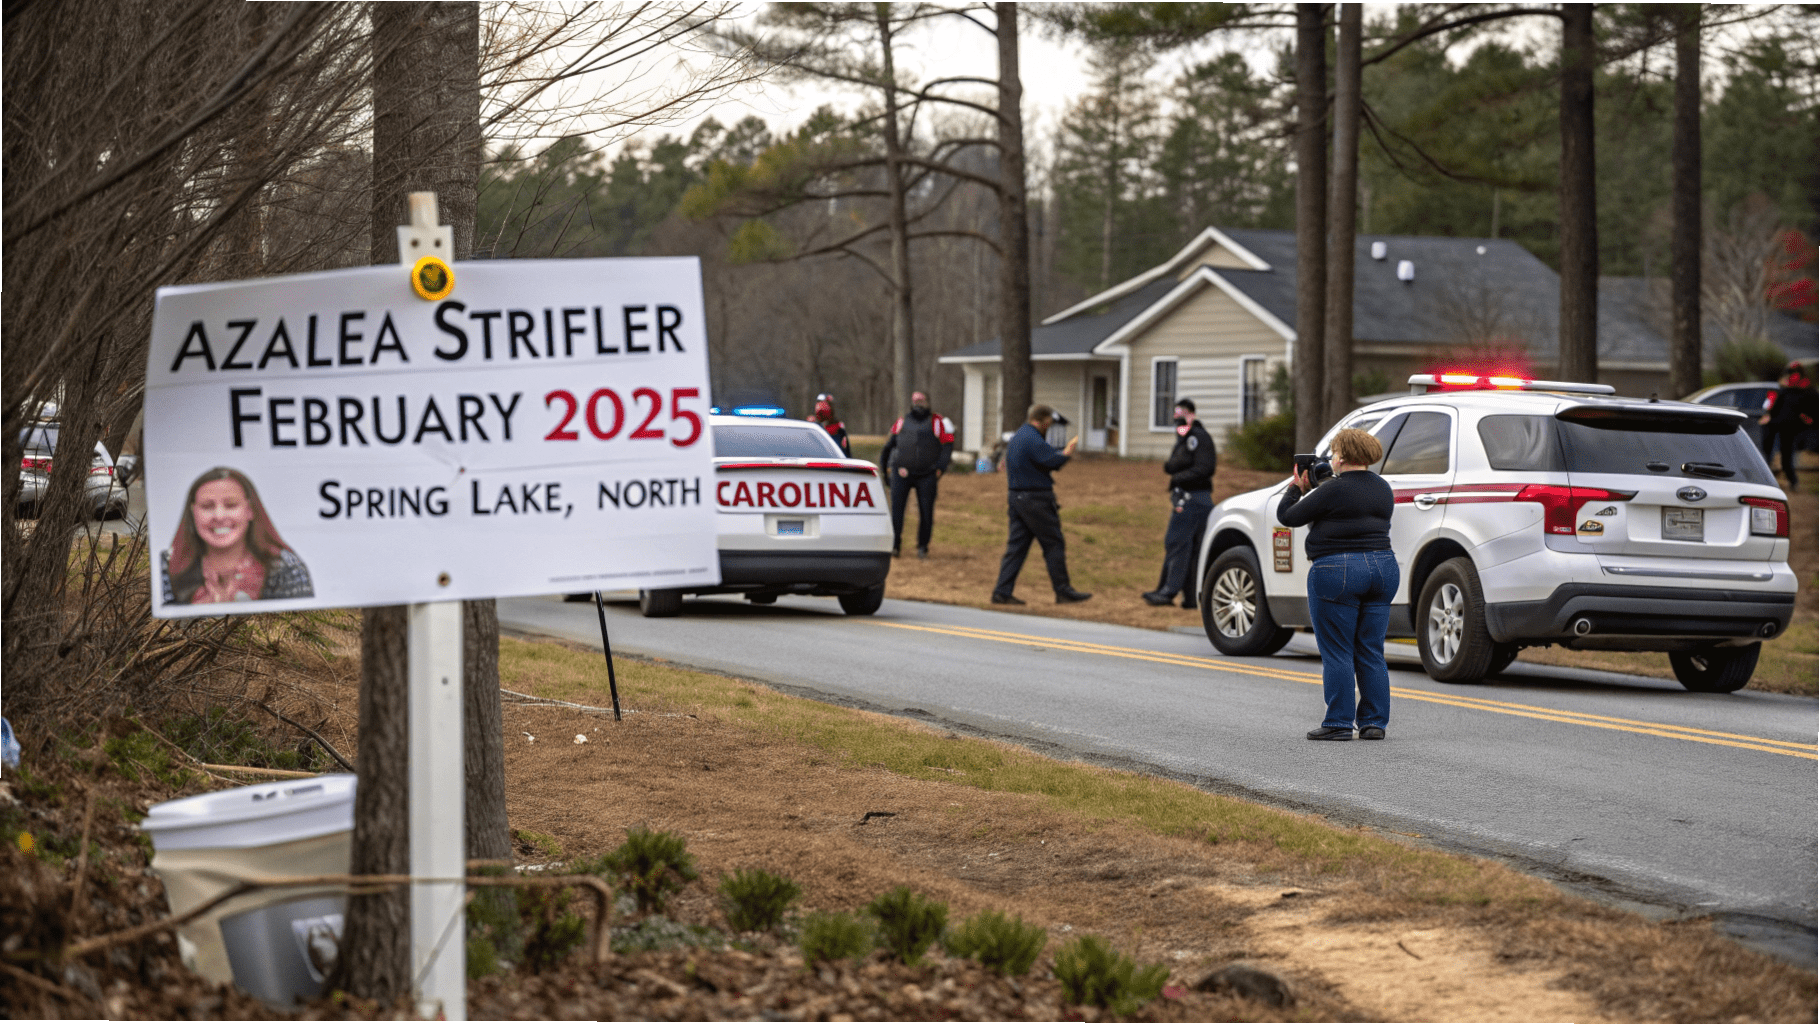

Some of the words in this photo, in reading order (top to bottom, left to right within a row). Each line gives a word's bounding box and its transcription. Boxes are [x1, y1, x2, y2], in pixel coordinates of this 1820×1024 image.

[170, 309, 410, 373] AZALEA
[432, 299, 686, 362] STRIFLER
[228, 386, 523, 448] FEBRUARY
[543, 386, 702, 448] 2025
[318, 479, 450, 519] SPRING
[471, 479, 574, 518] LAKE,
[598, 477, 701, 510] NORTH
[716, 480, 875, 508] CAROLINA
